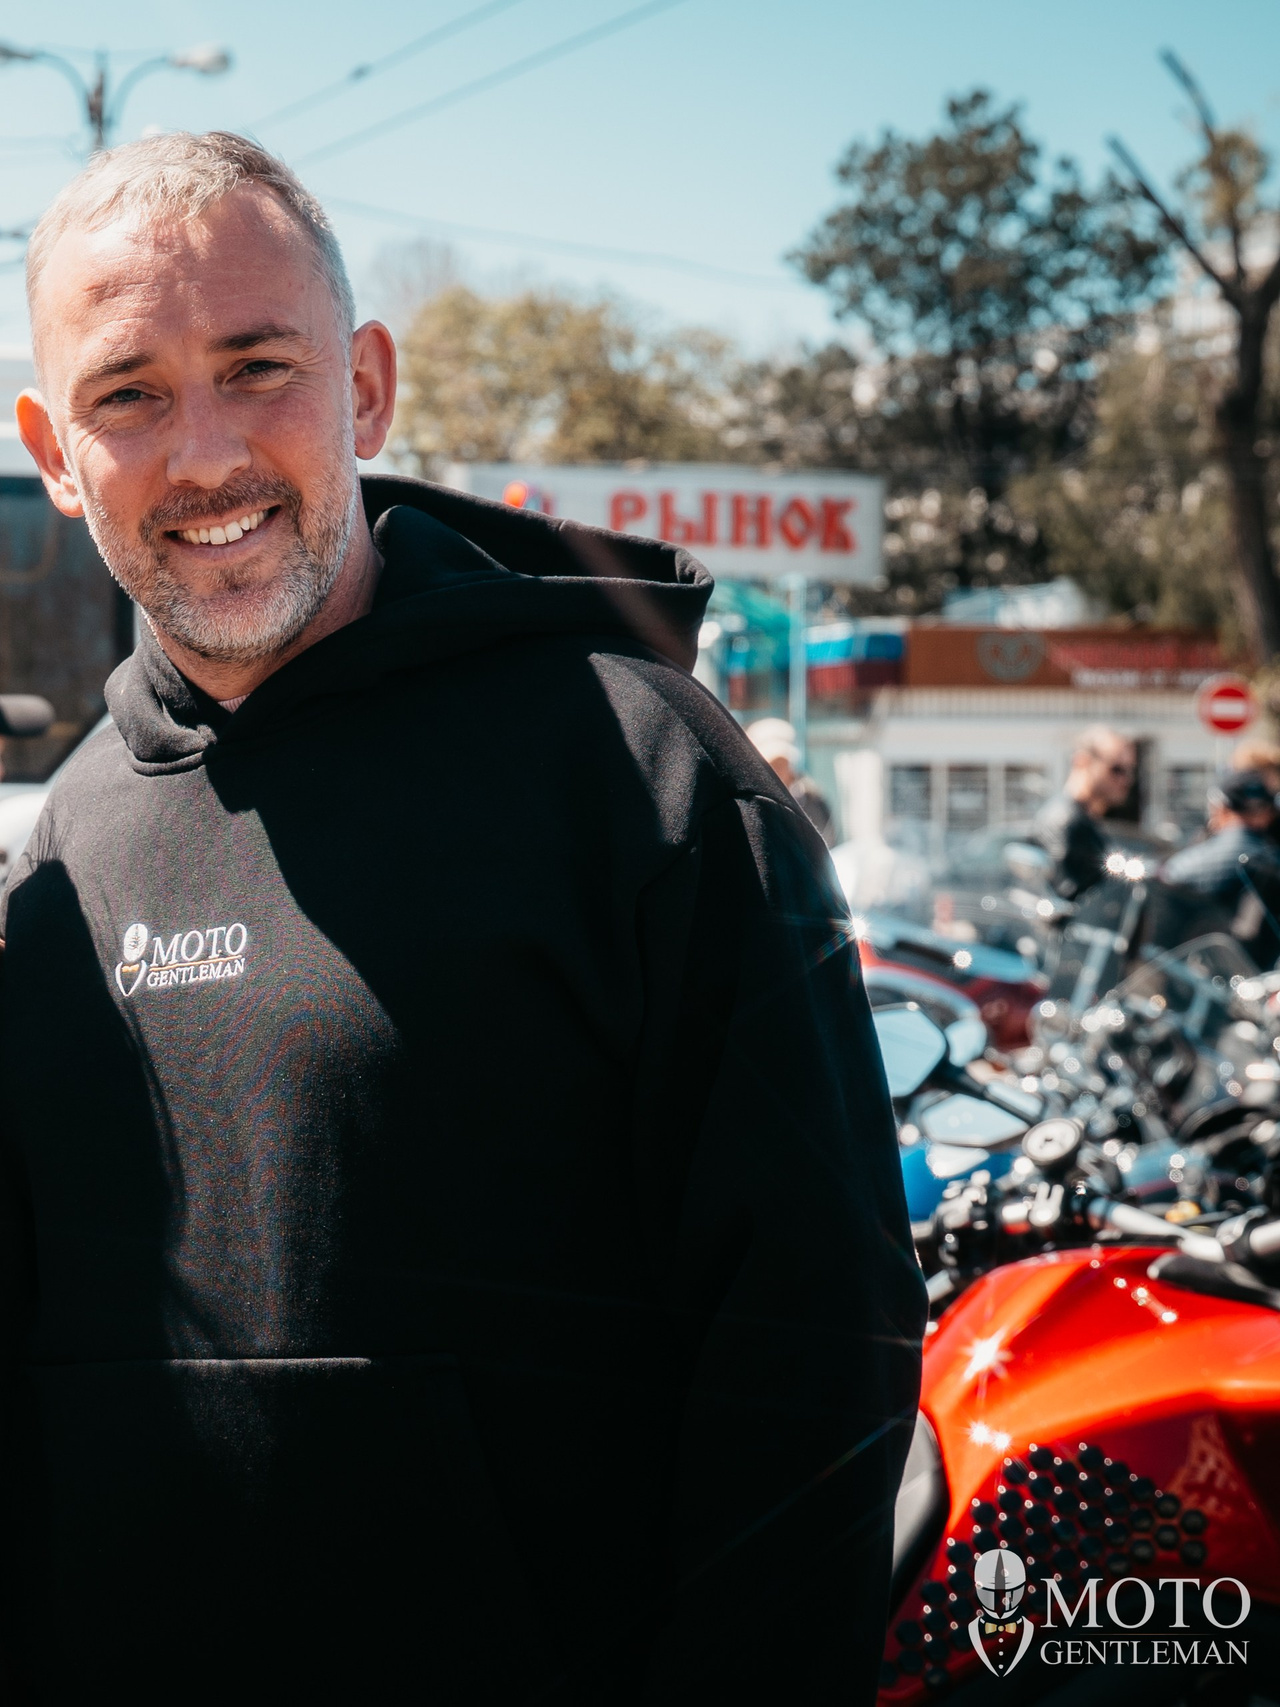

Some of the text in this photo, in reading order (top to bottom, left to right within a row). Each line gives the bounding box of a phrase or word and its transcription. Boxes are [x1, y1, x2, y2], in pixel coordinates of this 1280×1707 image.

[609, 491, 857, 554] РЫНОК
[150, 923, 247, 967] MOTO
[146, 958, 245, 987] GENTLEMAN
